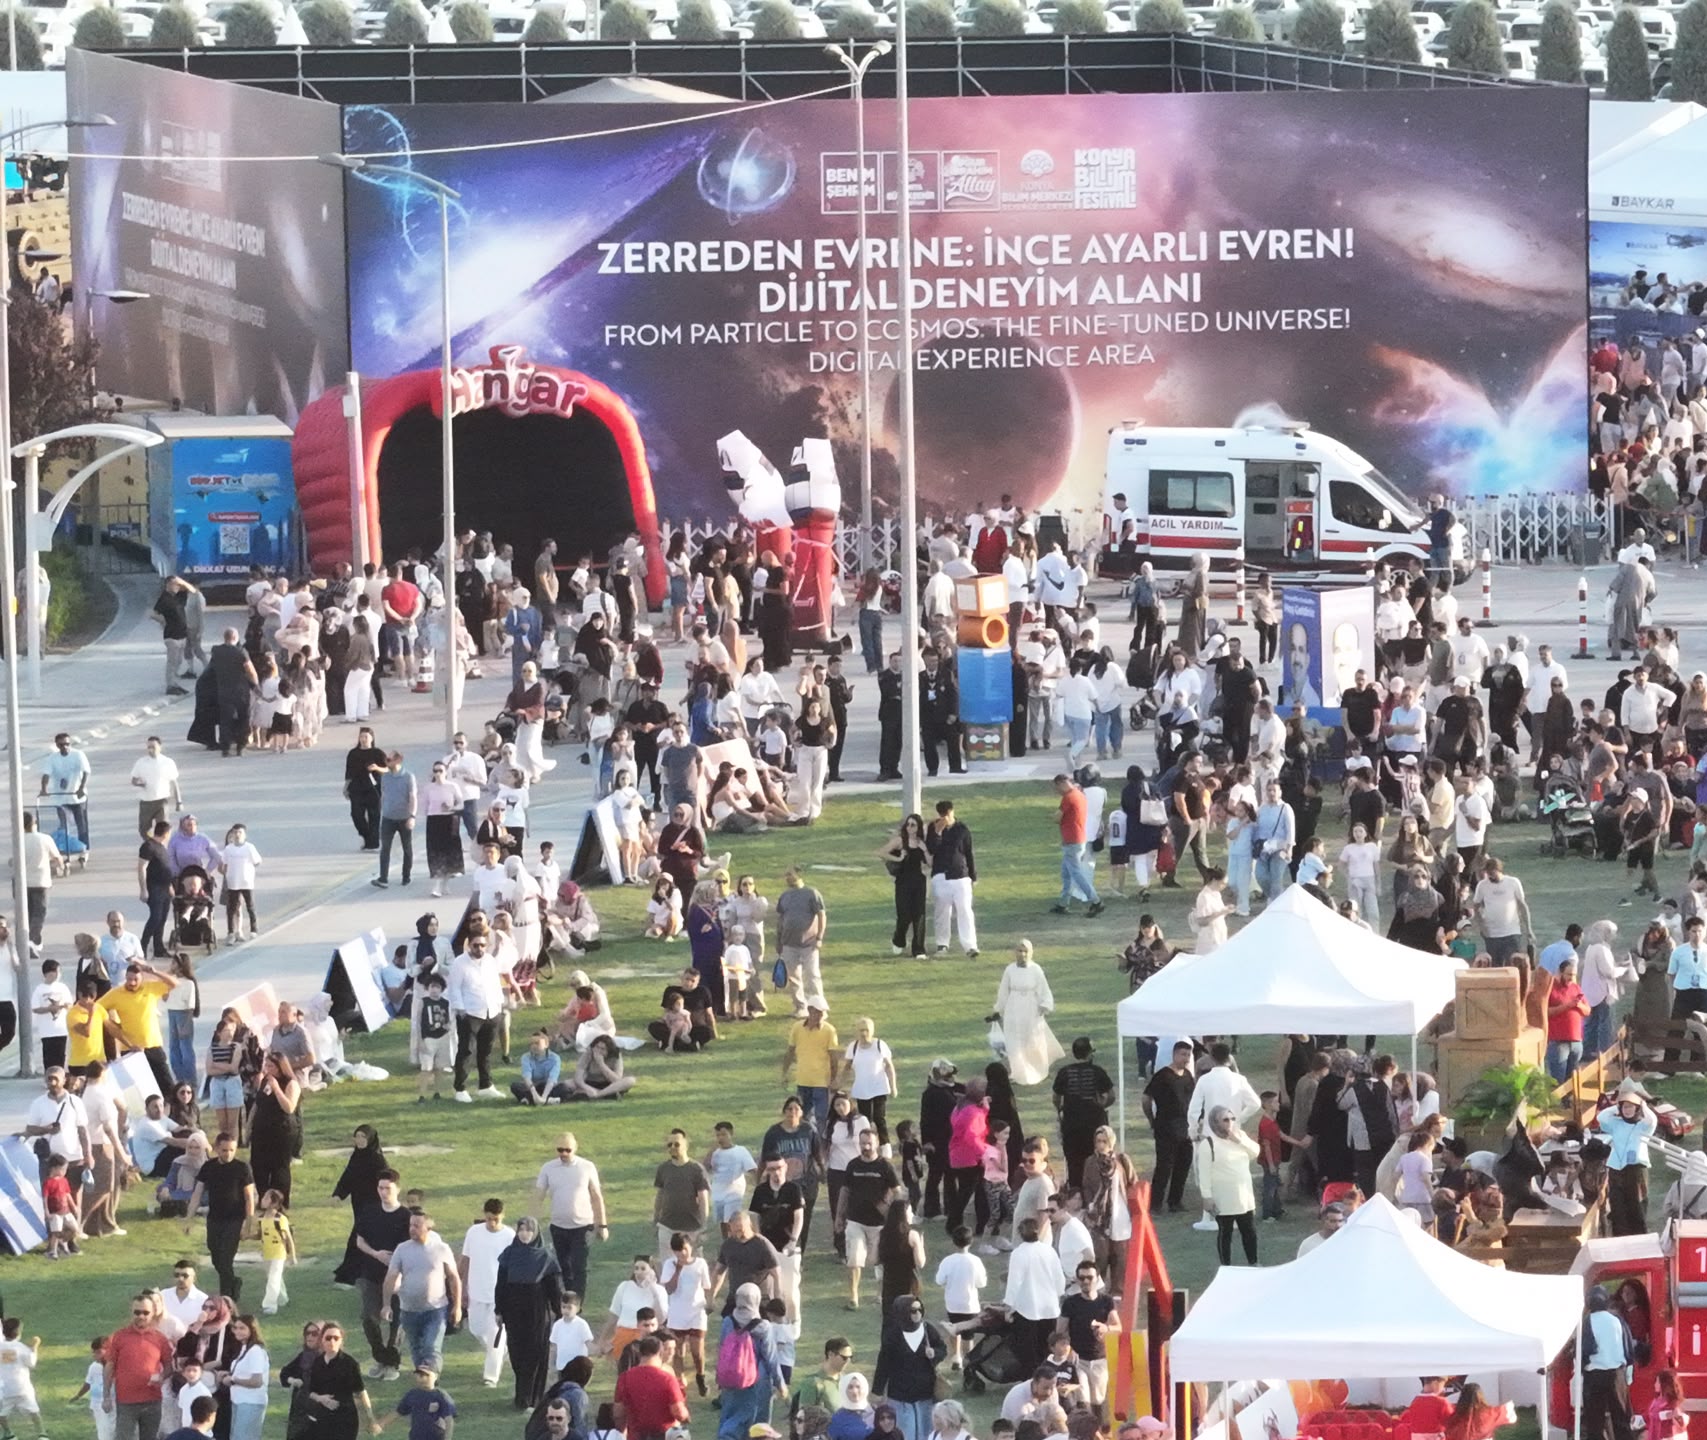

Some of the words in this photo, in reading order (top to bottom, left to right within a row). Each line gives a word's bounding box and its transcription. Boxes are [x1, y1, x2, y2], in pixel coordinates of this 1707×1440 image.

[826, 168, 876, 183] BENM
[1620, 196, 1675, 209] BAYKAR
[597, 239, 803, 274] ZERREDEN
[984, 227, 1073, 267] İNCE
[1080, 231, 1208, 264] AYARLI
[1218, 228, 1354, 261] EVREN!
[759, 271, 898, 313] DİJİTAL
[909, 267, 1078, 309] DENEYİM
[1088, 272, 1201, 305] ALANI
[604, 324, 682, 346] FROM
[690, 321, 813, 344] PARTICLE
[820, 320, 858, 342] TO
[991, 316, 1042, 338] THE
[1049, 312, 1209, 337] FINE-TUNED
[1216, 308, 1351, 332] UNIVERSE!
[916, 345, 1081, 371] EXPERIENCE
[1086, 344, 1156, 366] AREA
[442, 350, 587, 417] Hangar
[1180, 519, 1224, 530] YARDIM
